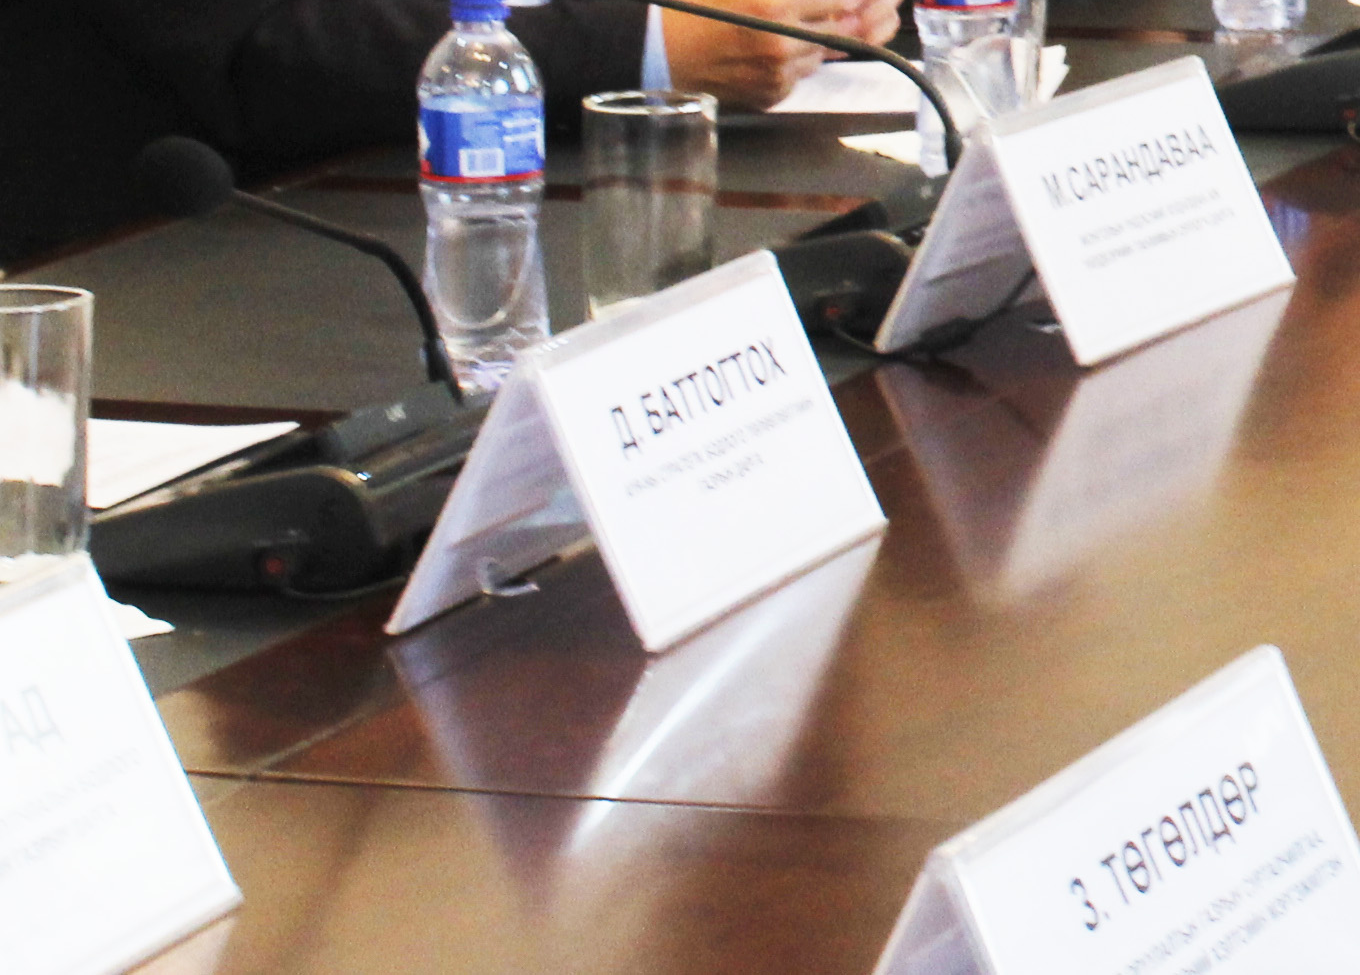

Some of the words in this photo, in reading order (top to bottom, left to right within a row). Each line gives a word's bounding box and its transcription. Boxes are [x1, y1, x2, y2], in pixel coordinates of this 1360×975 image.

[1041, 124, 1218, 209] М.САРАНДАВАА
[639, 336, 788, 435] БАТТОГТОХ
[1101, 761, 1260, 905] ТӨГӨЛДӨР
